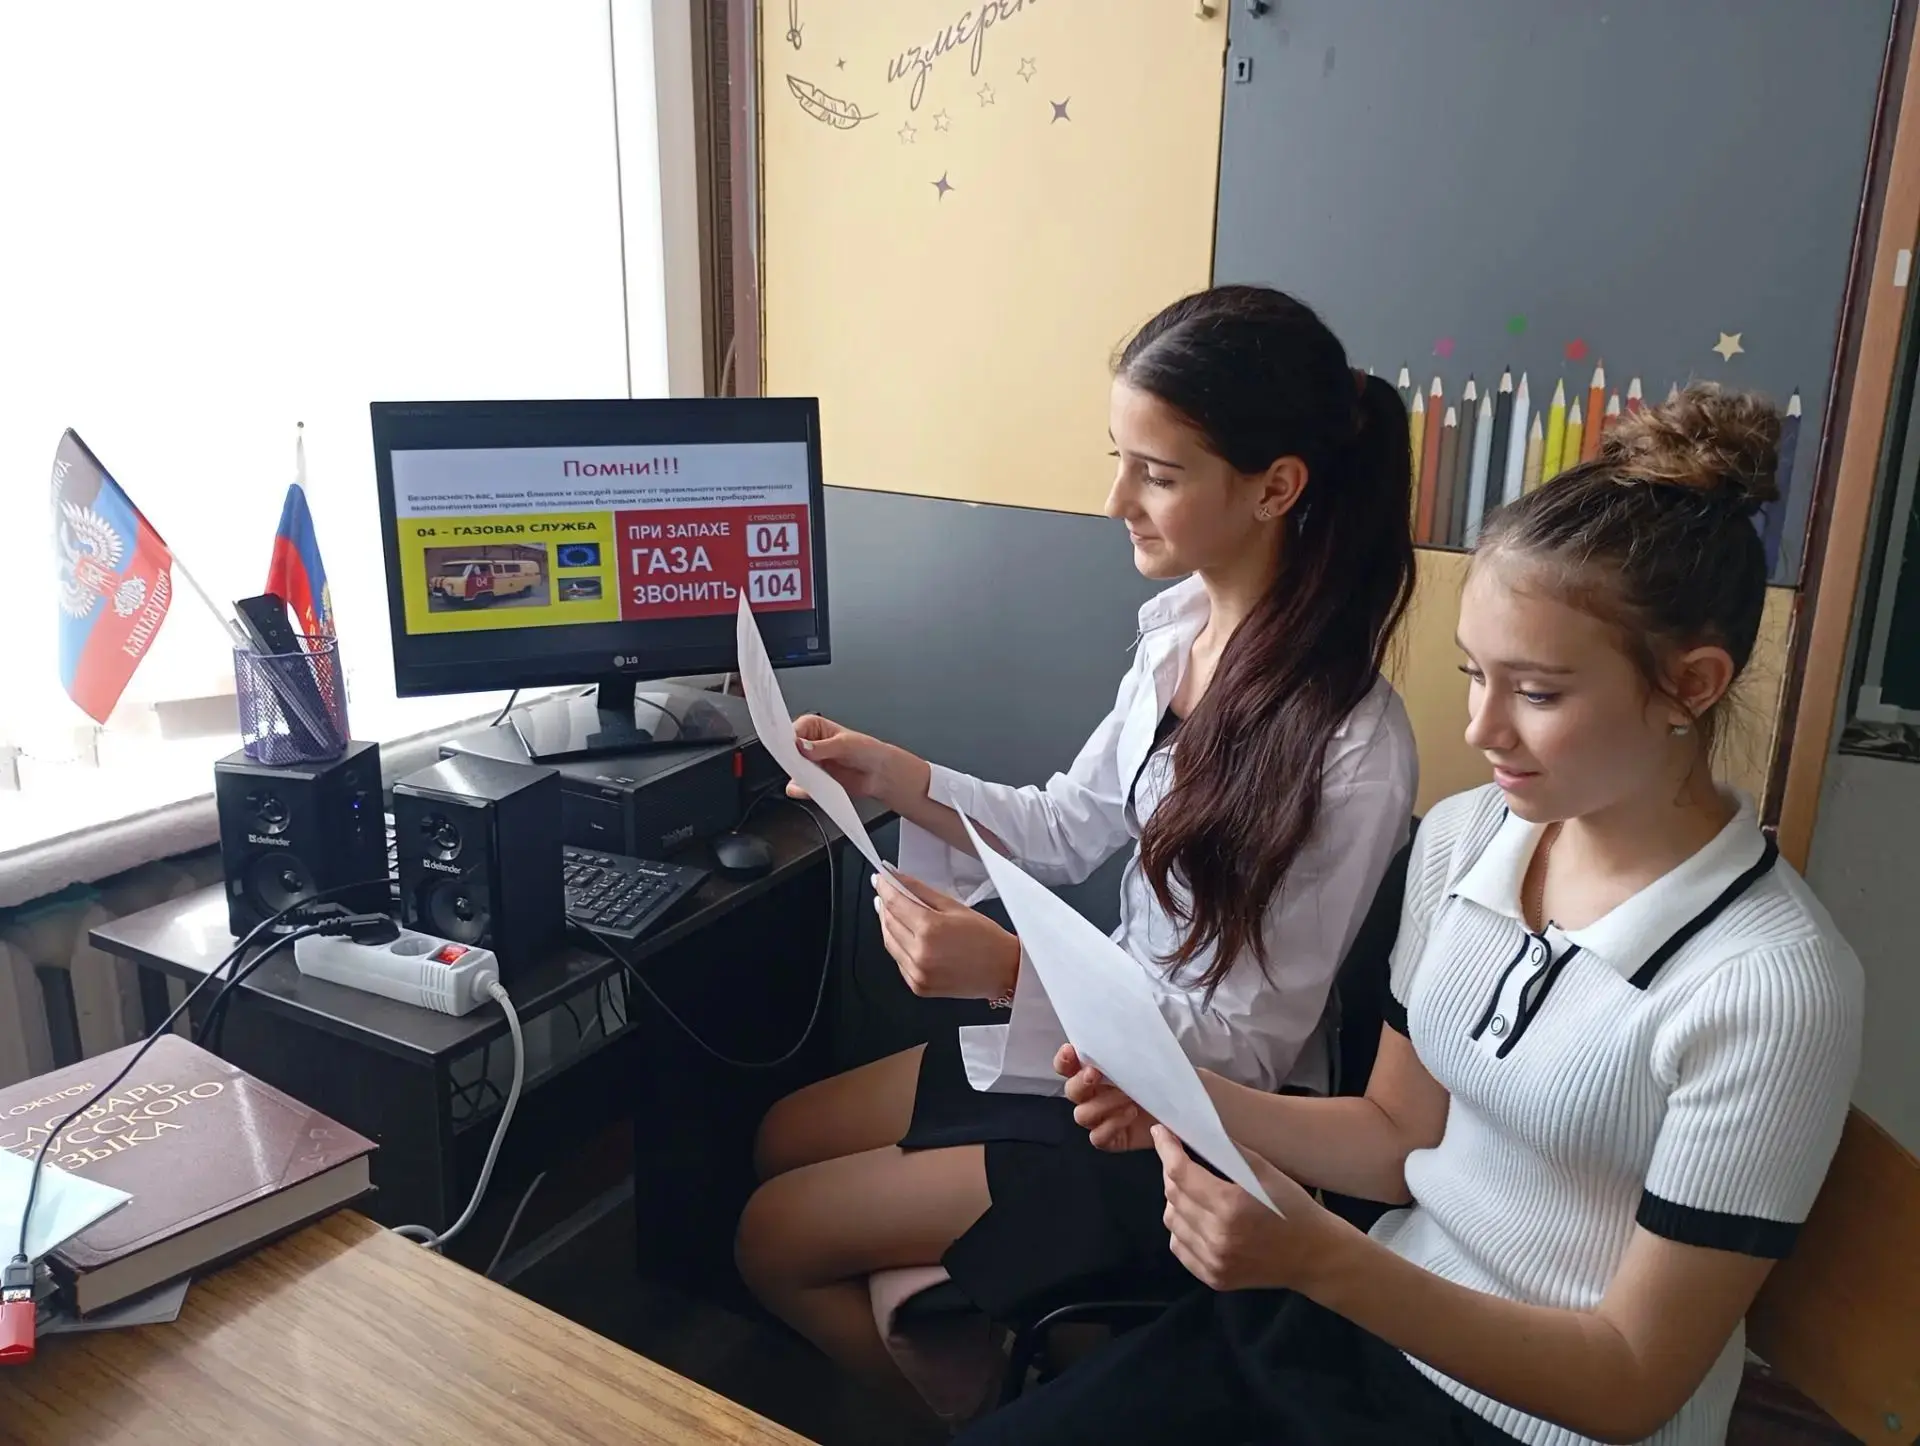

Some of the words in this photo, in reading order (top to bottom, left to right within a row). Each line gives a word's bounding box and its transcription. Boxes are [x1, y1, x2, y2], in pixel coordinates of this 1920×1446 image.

[887, 0, 1036, 111] измере
[563, 456, 679, 478] Помни!!!
[407, 493, 473, 502] Безопасность
[527, 490, 564, 498] близких
[574, 488, 612, 498] соседей
[613, 487, 646, 495] зависит
[660, 486, 715, 494] правильного
[723, 483, 793, 493] своевременного
[410, 502, 471, 511] выполнения
[472, 502, 498, 510] вами
[499, 501, 533, 510] правил
[536, 499, 594, 508] пользования
[595, 497, 637, 506] бытовым
[672, 495, 715, 503] газовыми
[753, 513, 796, 521] ГОРОДСКОГО
[417, 528, 436, 537] 04
[454, 524, 525, 536] ГАЗОВАЯ
[529, 522, 597, 533] СЛУЖБА
[628, 525, 662, 540] ПРИ
[666, 522, 731, 538] ЗАПАХЕ
[756, 526, 790, 553] 04
[631, 546, 713, 575] ГАЗА
[475, 576, 488, 587] 04
[754, 573, 797, 598] 104
[632, 581, 737, 605] ЗВОНИТЬ
[626, 656, 638, 664] LG
[257, 835, 291, 847] defender
[430, 861, 462, 875] defender
[9, 1082, 97, 1116] ОЖЕГОВ
[45, 1120, 185, 1170] ЗЫКА
